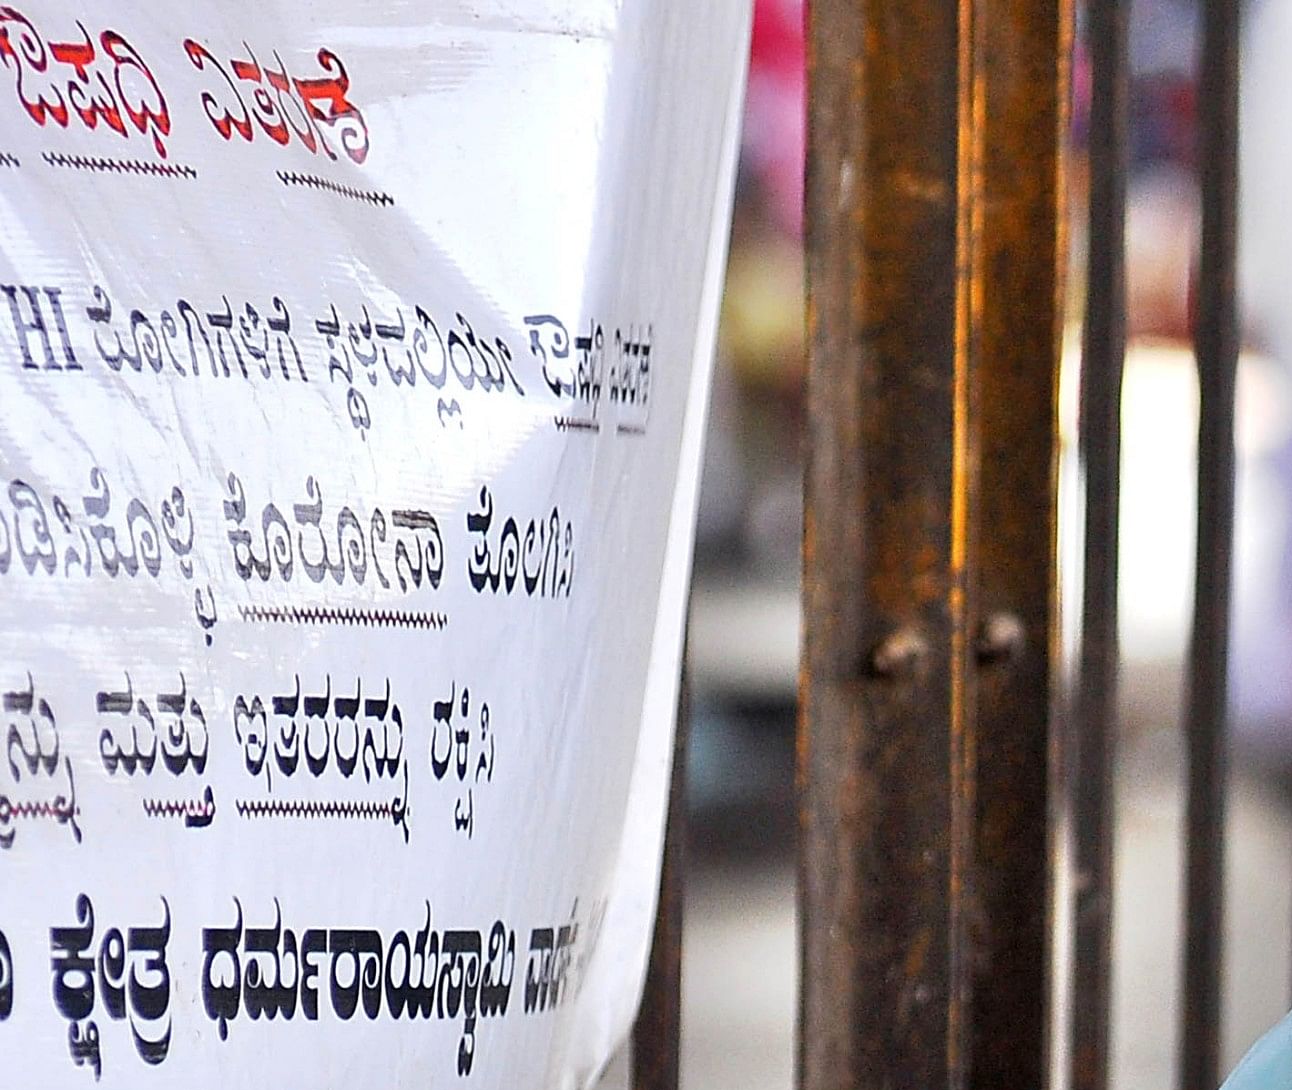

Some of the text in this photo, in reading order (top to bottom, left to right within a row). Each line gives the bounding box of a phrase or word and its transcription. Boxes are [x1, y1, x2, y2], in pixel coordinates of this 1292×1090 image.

[184, 38, 370, 165] ವಿತರಣೆ
[97, 671, 216, 828] ಮತ್ತು
[234, 674, 409, 843] ಇತರರನ್ನು
[50, 892, 172, 1082] ಕ್ಷೇತ್ರ
[202, 895, 515, 1077] ಧರ್ಮರಾಯಸ್ವಾಮಿ
